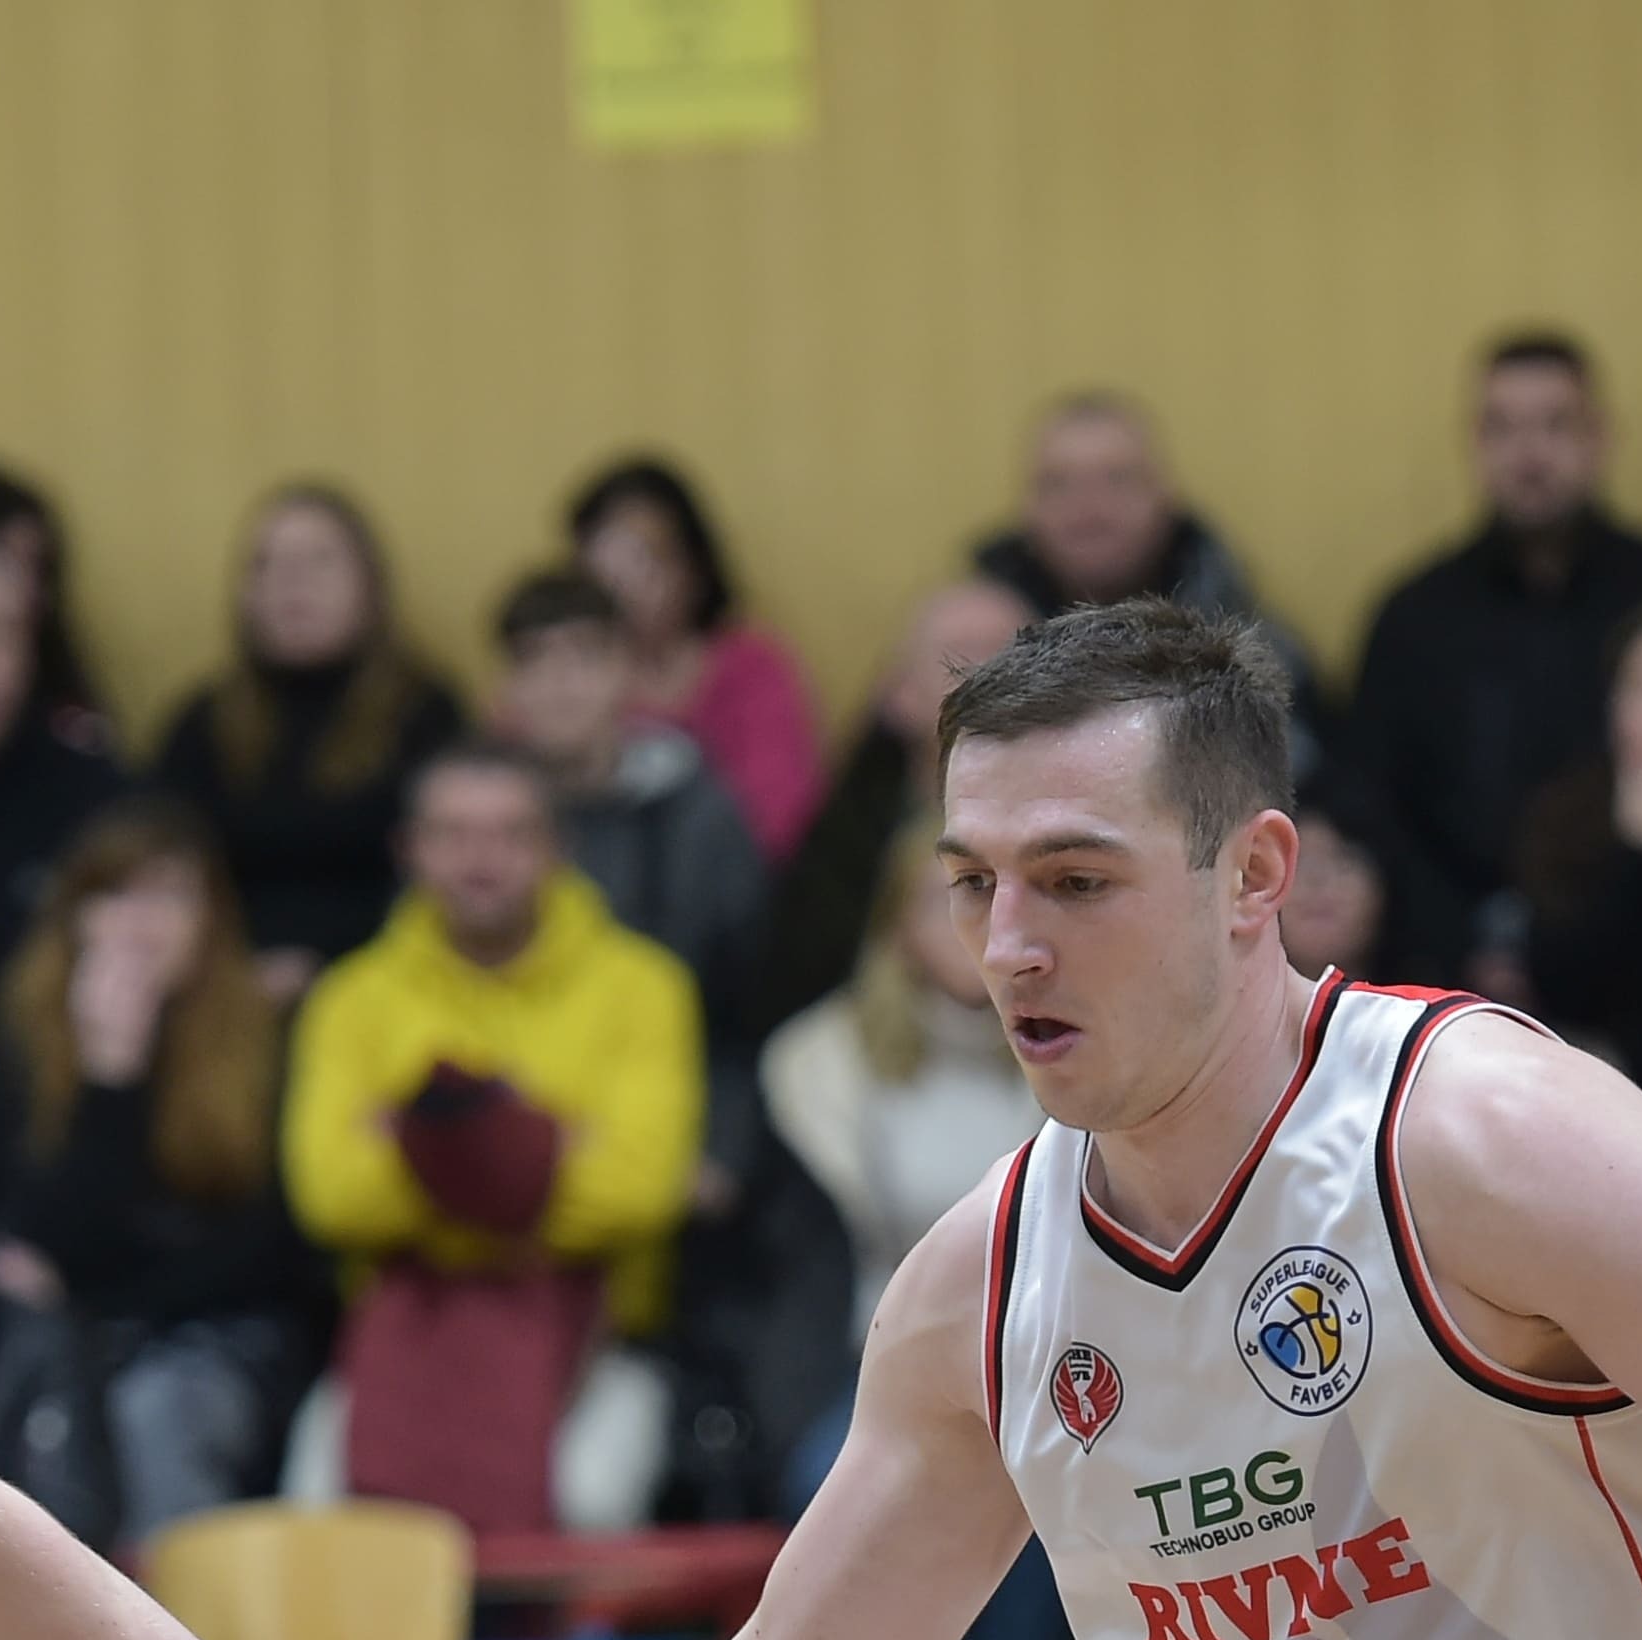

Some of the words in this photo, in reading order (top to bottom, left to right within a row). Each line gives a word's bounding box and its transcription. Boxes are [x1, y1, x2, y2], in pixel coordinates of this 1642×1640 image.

[1251, 1260, 1350, 1313] SUPERLEAGUE
[1290, 1363, 1352, 1405] FAVBET
[1133, 1450, 1304, 1537] TBG
[1149, 1521, 1255, 1559] TECHNOBUD
[1256, 1502, 1317, 1533] GROUP
